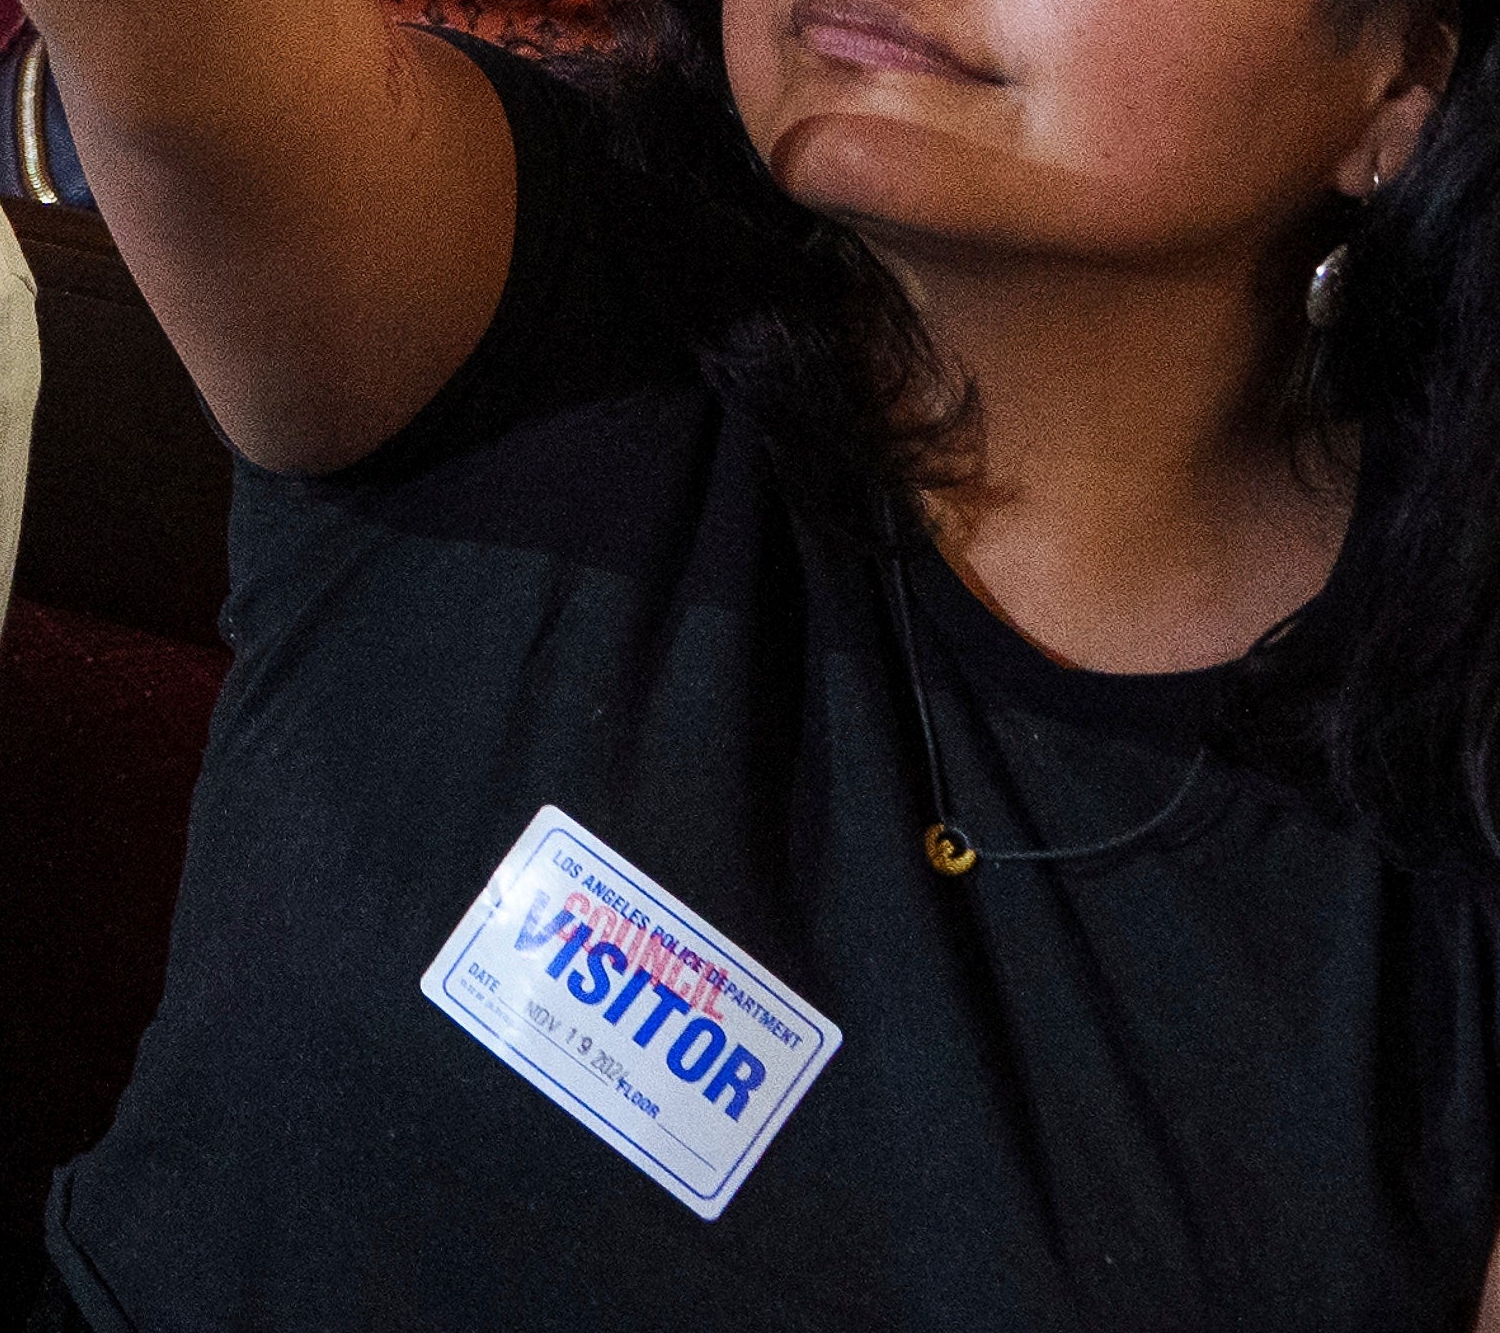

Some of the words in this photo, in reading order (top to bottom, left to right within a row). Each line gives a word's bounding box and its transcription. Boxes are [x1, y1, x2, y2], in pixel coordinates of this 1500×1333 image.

[468, 961, 500, 994] DATE
[513, 888, 767, 1123] VISITOR
[551, 849, 584, 879] LOS
[582, 874, 650, 930] ANGELES
[651, 925, 706, 973] POLICE
[706, 967, 804, 1051] DEPARTMENT
[614, 1075, 661, 1119] FLOOR
